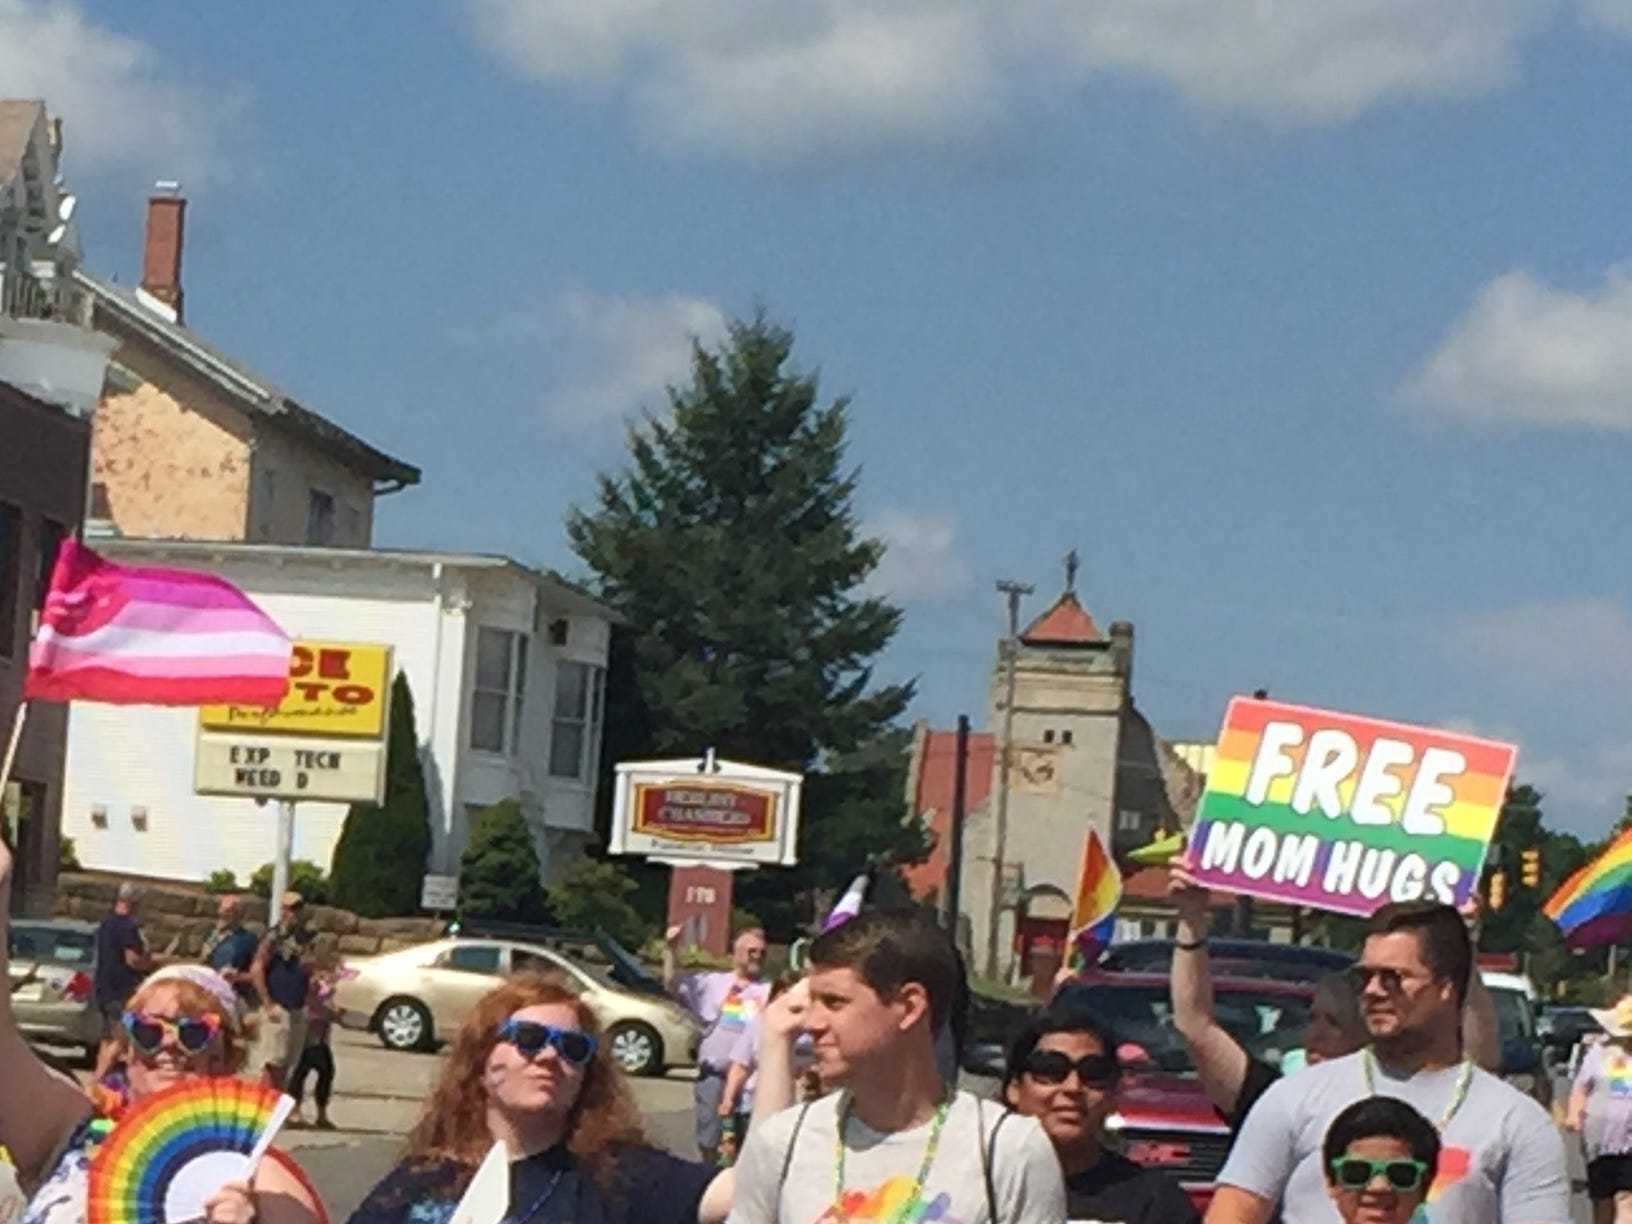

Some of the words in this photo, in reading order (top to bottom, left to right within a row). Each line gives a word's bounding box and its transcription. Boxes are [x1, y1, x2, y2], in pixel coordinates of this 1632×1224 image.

[294, 750, 342, 769] TECH
[1245, 721, 1465, 835] FREE
[1201, 820, 1318, 888] MOM
[1322, 839, 1461, 904] HUGS
